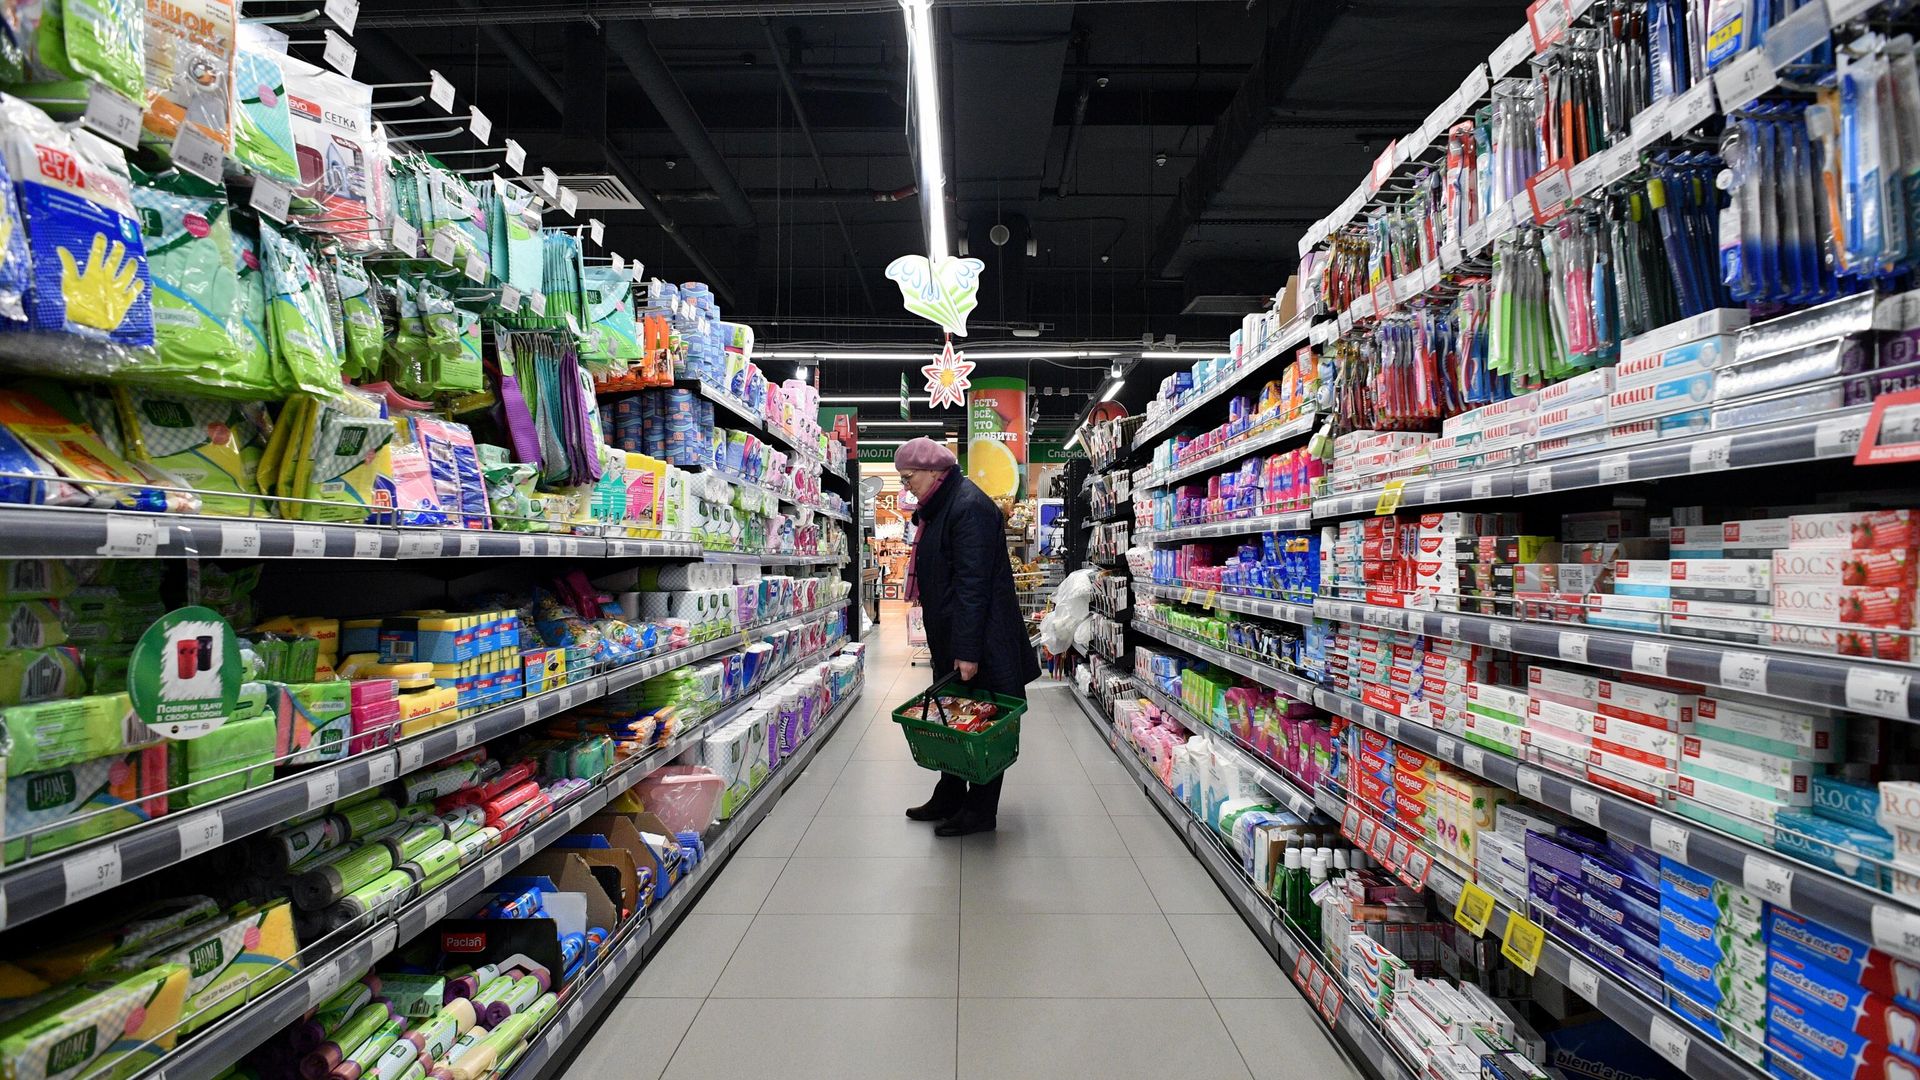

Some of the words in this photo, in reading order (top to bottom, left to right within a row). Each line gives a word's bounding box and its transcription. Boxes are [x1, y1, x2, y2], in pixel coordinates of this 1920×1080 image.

[324, 111, 357, 130] СЕТКА
[1618, 353, 1664, 377] LACALUT
[1541, 383, 1569, 401] LACALUT
[1611, 386, 1655, 408] LACALUT
[974, 398, 998, 407] ЕСТЬ
[1483, 402, 1508, 418] LACALUT
[974, 408, 994, 419] ВСЁ,
[1539, 408, 1568, 427] LACALUT
[974, 420, 993, 430] ЧТО
[1484, 425, 1508, 440] LACALUT
[974, 431, 1018, 441] ЛЮБИТЕ
[1417, 562, 1437, 572] Colgate
[527, 656, 542, 667] vileda
[1424, 655, 1446, 668] Colgate
[1423, 680, 1445, 693] Colgate
[409, 706, 431, 718] vileda
[1365, 732, 1384, 749] Colgate
[1361, 752, 1381, 770] Colgate
[1397, 749, 1422, 768] Colgate
[34, 774, 70, 803] HOME
[1361, 776, 1380, 792] Colgate
[1395, 772, 1422, 791] Colgate
[1396, 794, 1422, 814] Colgate
[446, 935, 482, 950] Paclan
[193, 941, 219, 970] HOME
